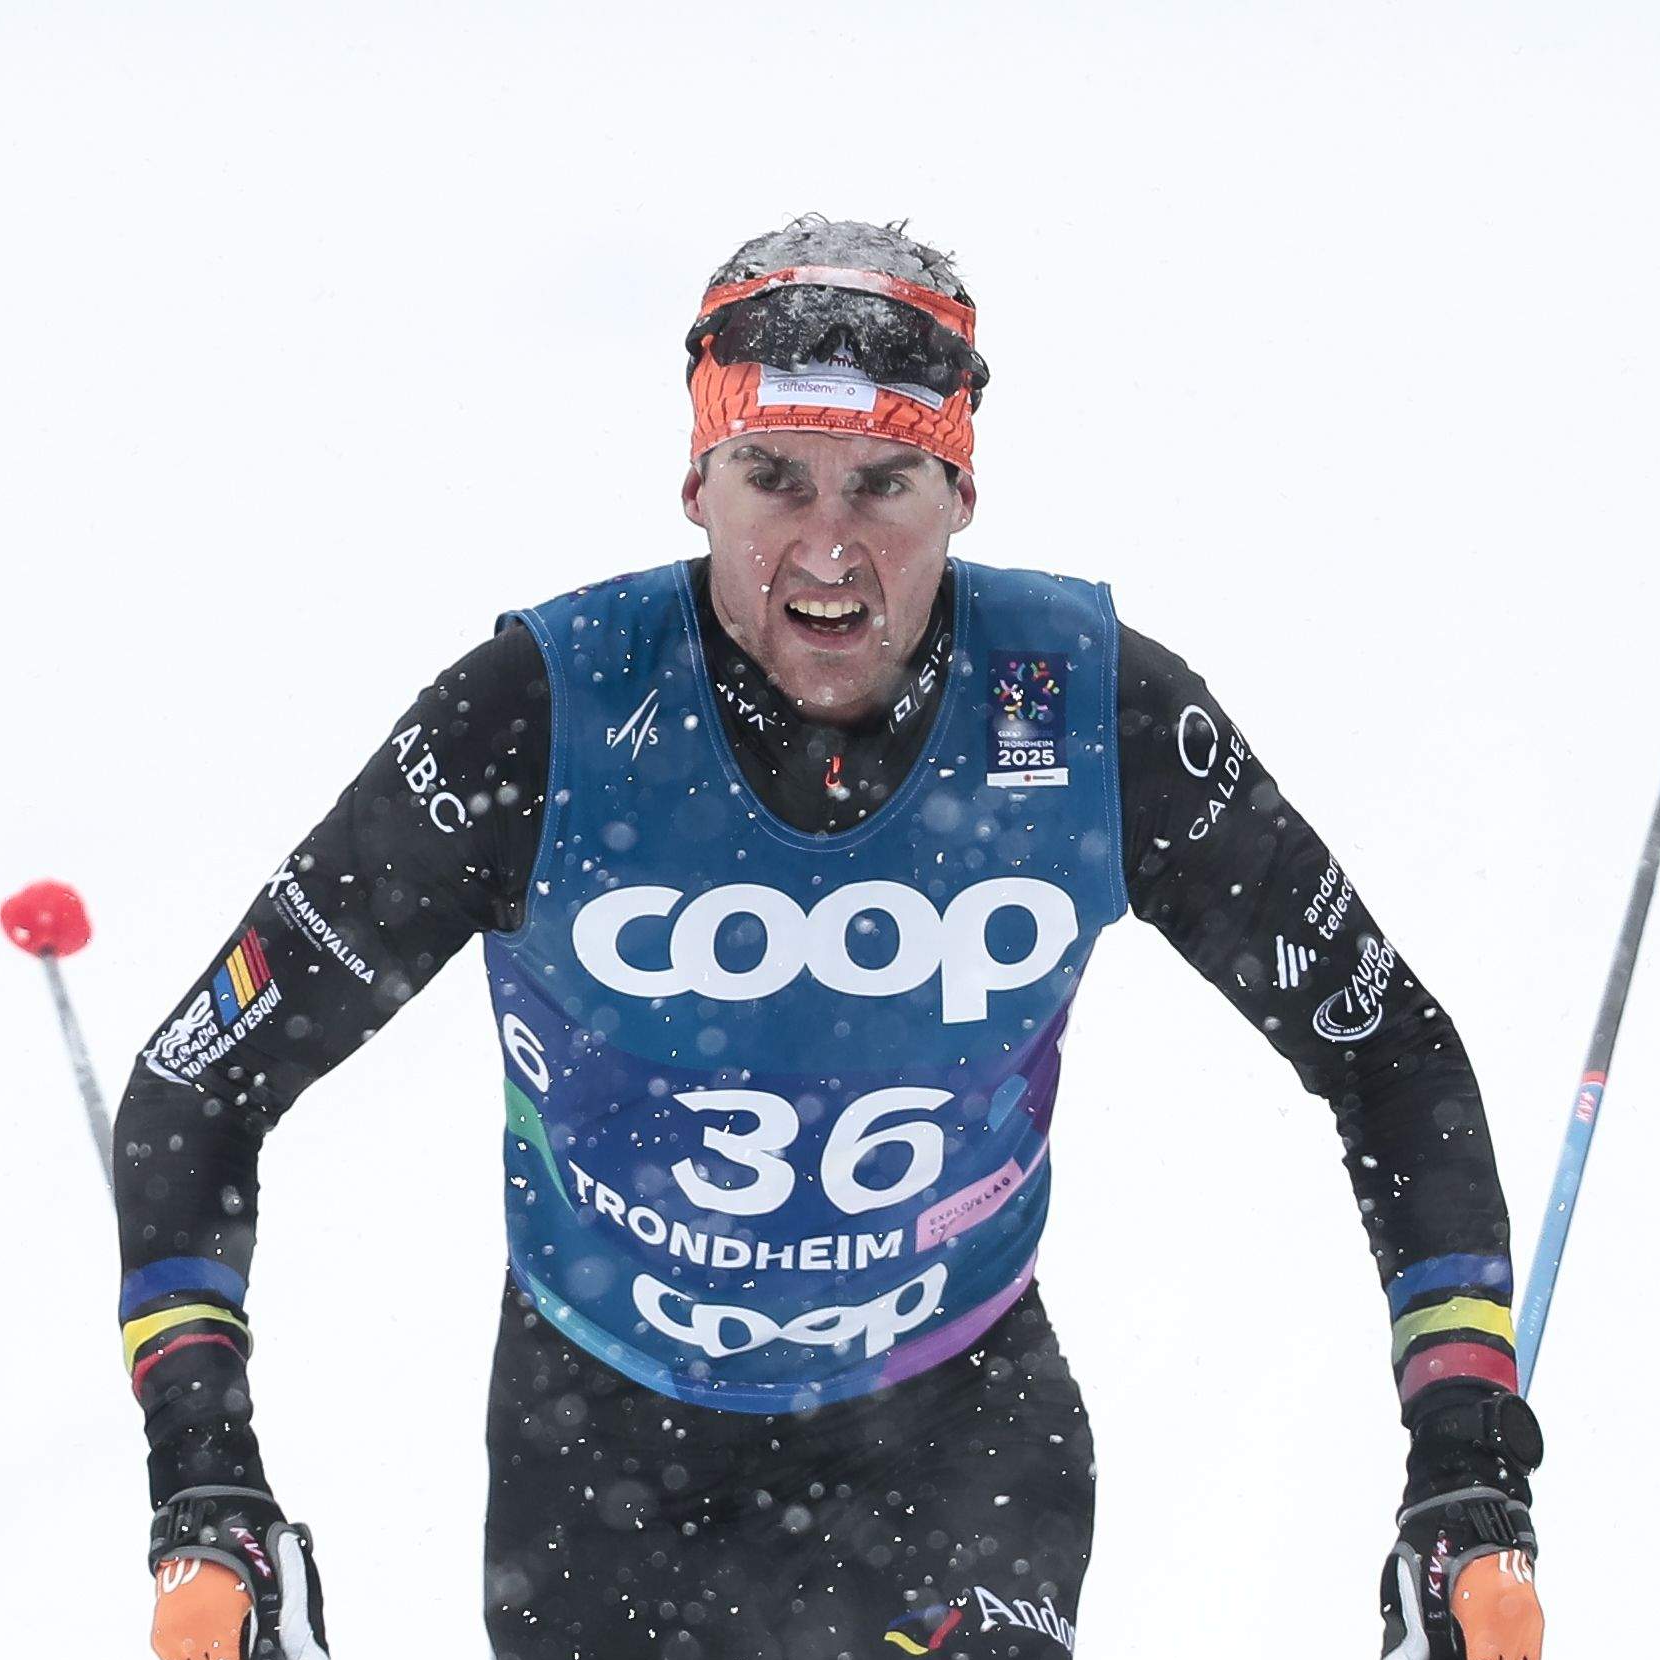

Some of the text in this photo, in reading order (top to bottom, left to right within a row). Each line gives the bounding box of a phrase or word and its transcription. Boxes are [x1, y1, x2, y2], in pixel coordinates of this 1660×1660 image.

[998, 749, 1055, 766] 2025
[1188, 724, 1244, 840] CALDE
[285, 881, 375, 984] GRANDVALIRA
[572, 876, 1079, 1024] coop
[671, 1086, 955, 1215] 36
[568, 1158, 904, 1271] TRONDHEIM
[632, 1262, 948, 1359] coop
